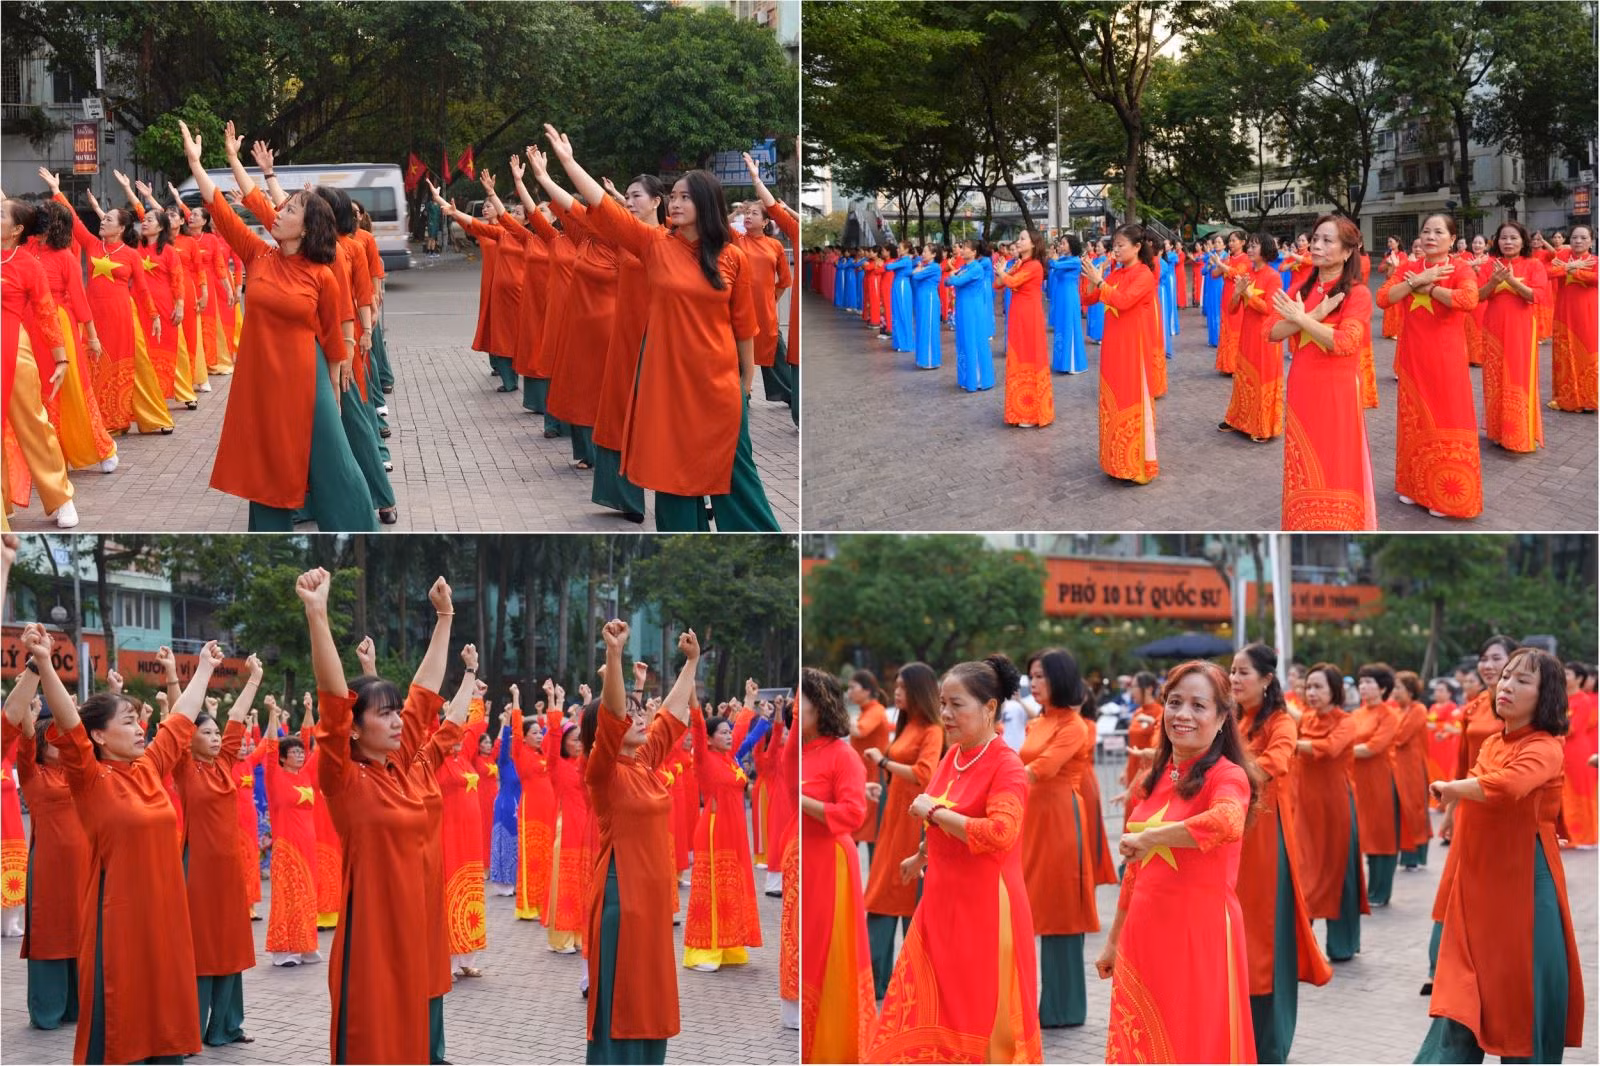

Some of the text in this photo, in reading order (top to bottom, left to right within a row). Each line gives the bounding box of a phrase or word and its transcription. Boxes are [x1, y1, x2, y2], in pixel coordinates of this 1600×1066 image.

[74, 138, 97, 152] HOTEL
[1058, 576, 1096, 604] PHỞ
[1103, 585, 1120, 605] 10
[1125, 580, 1146, 606] LÝ
[1151, 580, 1197, 610] QUỐC
[1, 644, 20, 669] LÝ
